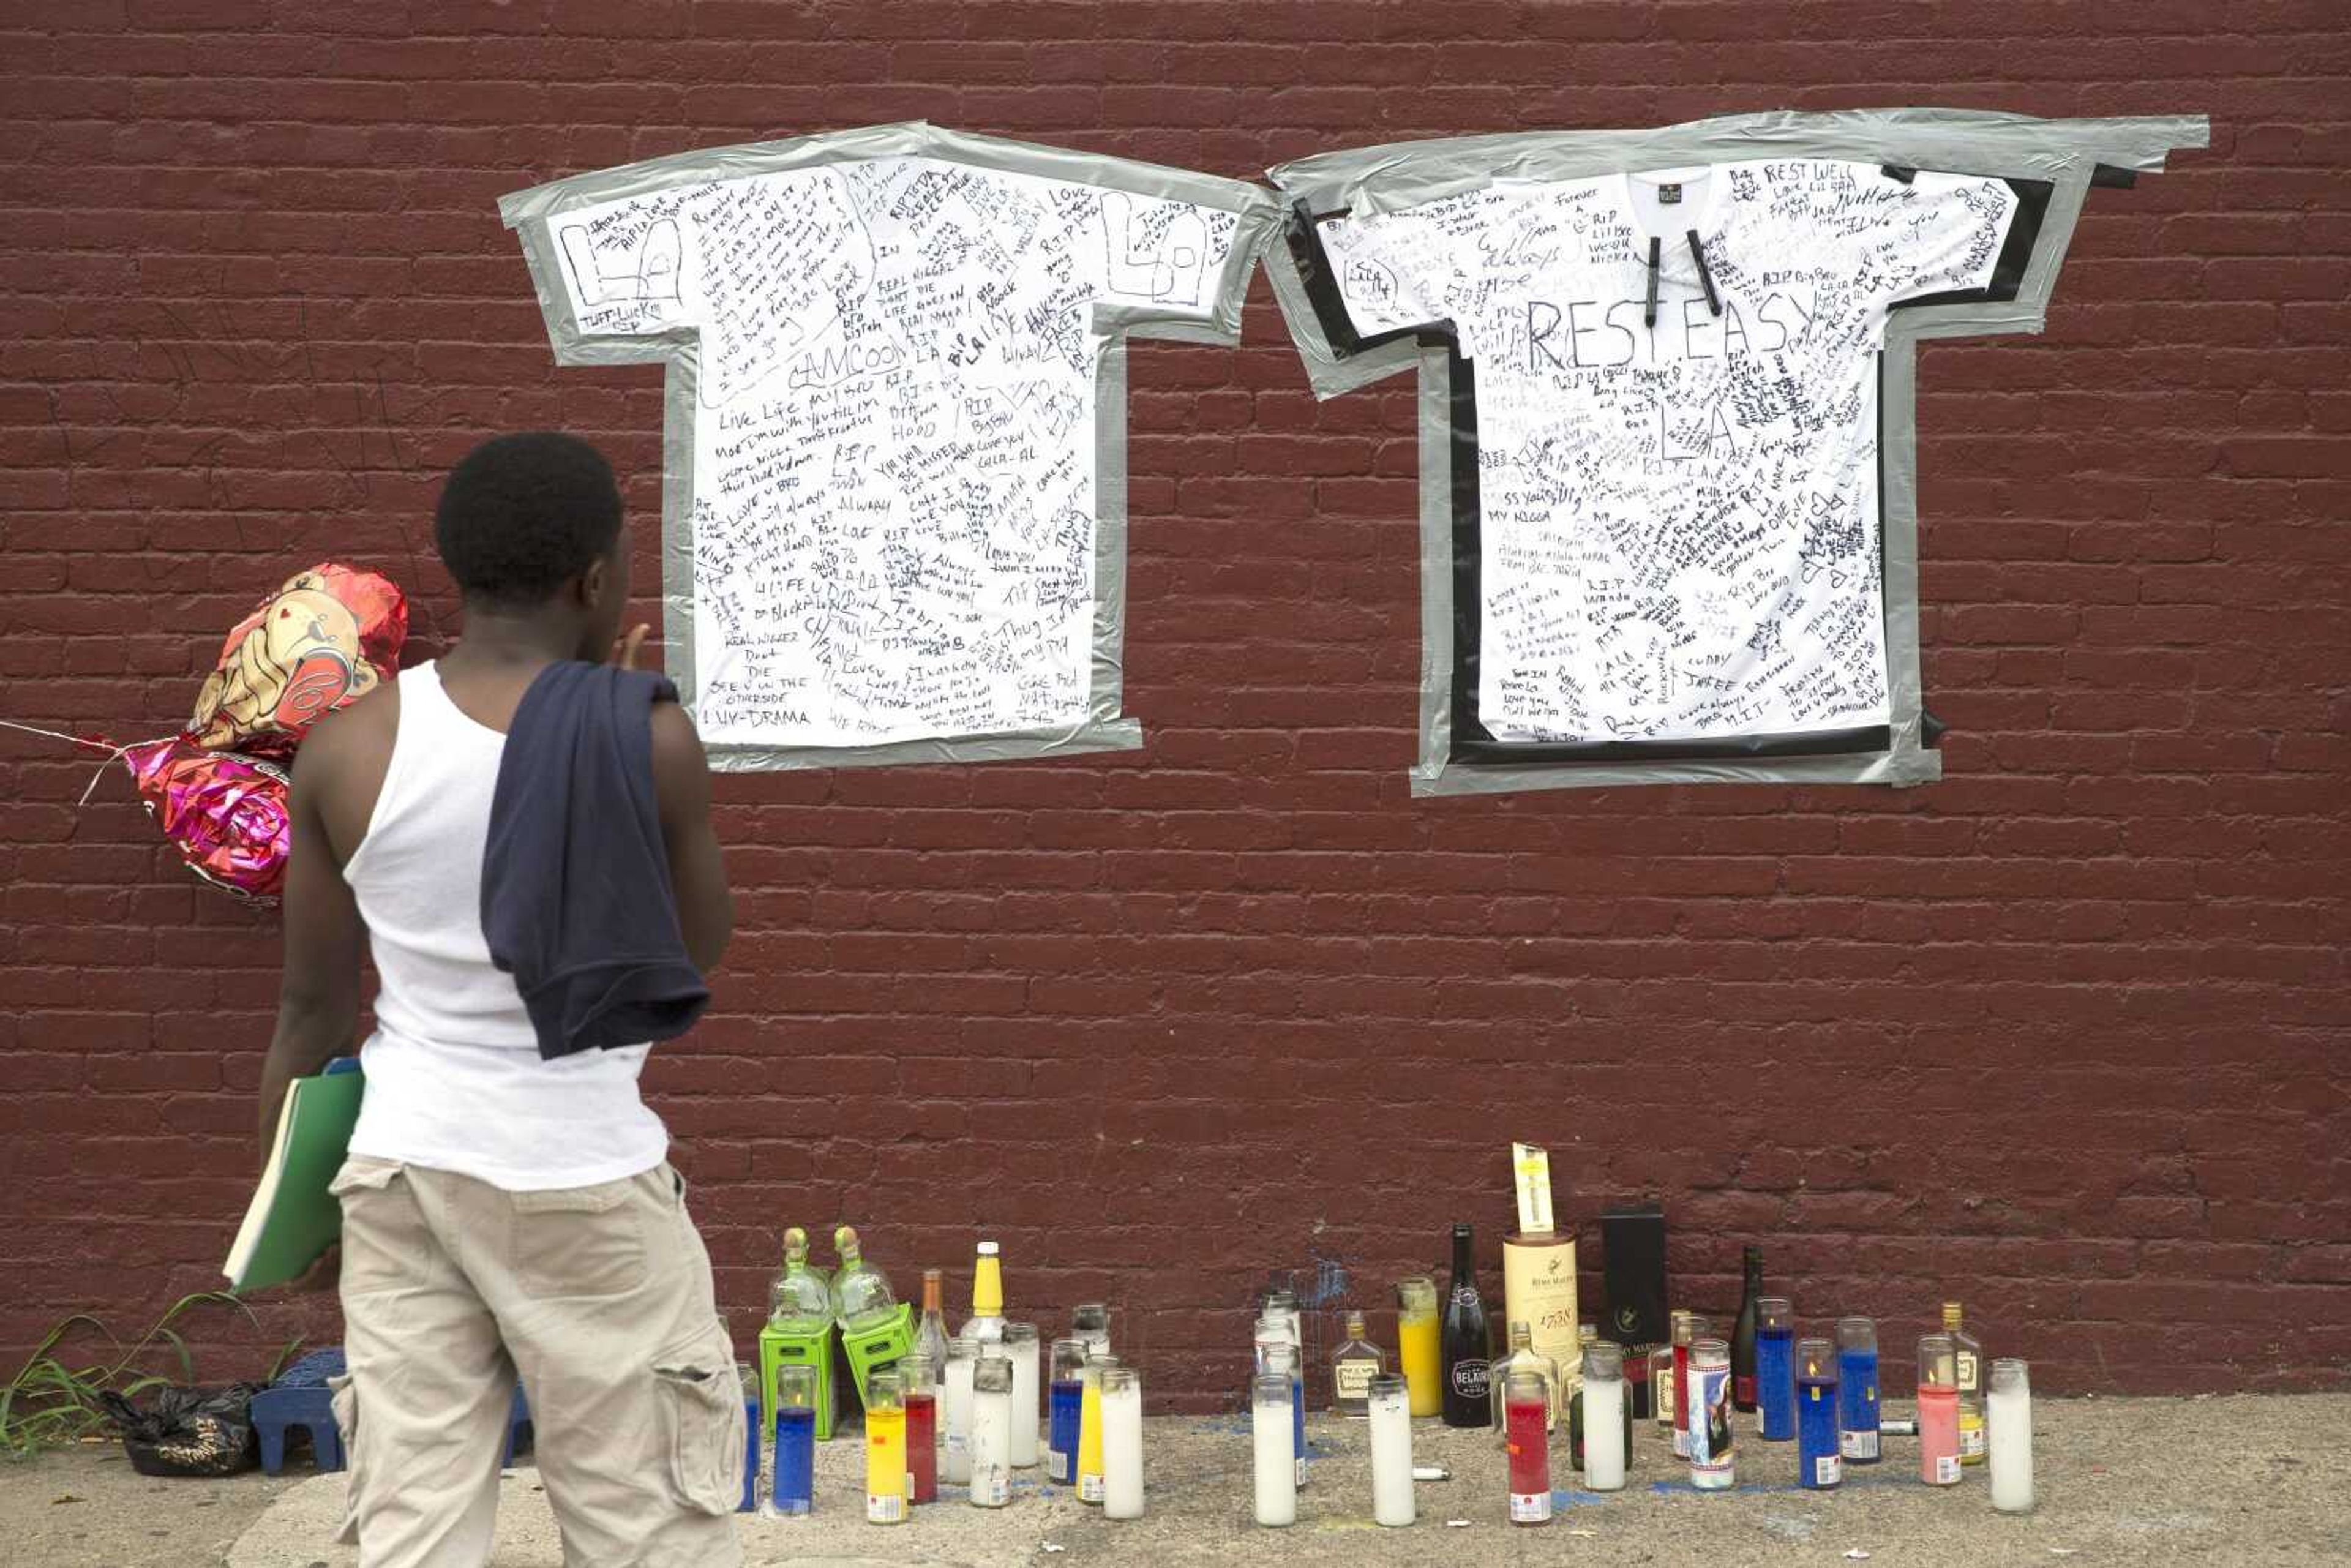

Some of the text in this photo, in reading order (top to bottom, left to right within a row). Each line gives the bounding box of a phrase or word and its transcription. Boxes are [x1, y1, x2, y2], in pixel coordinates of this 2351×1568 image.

[1764, 163, 1807, 183] REST
[1528, 299, 1668, 371] REST
[1684, 292, 1814, 360] EASY
